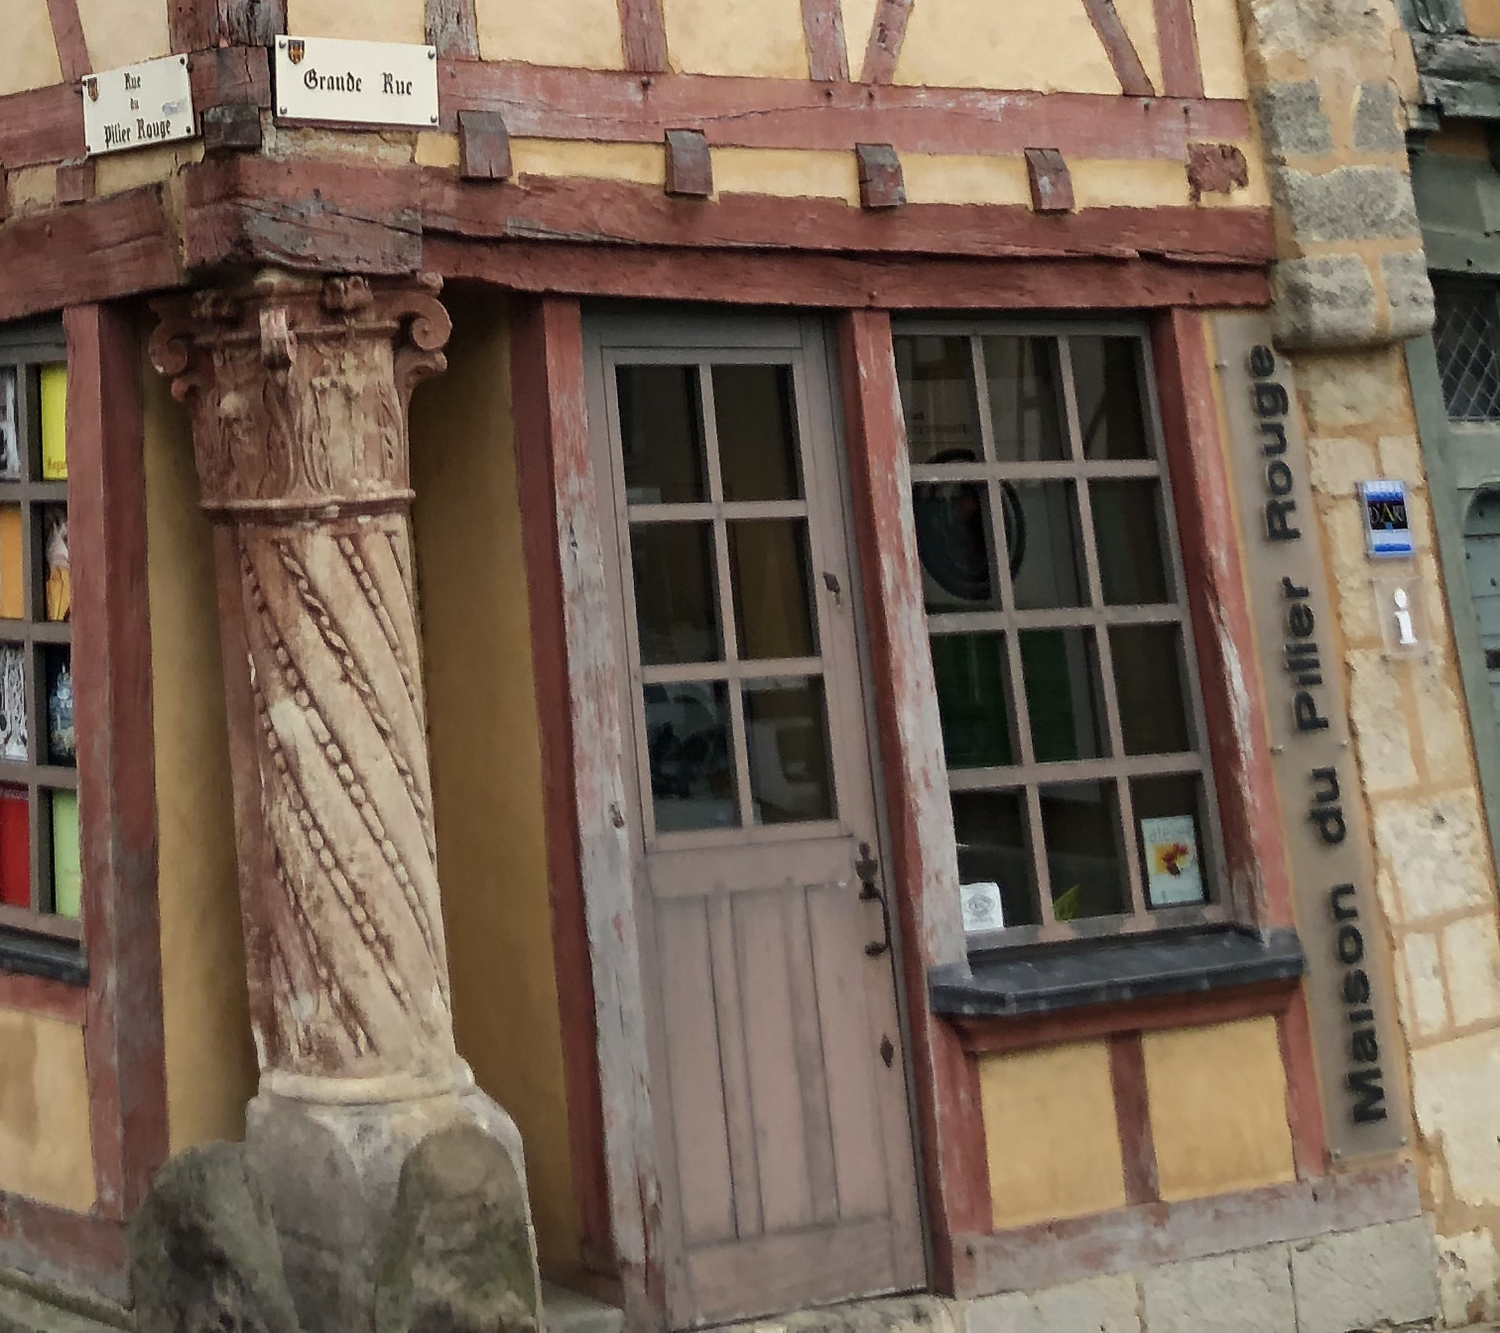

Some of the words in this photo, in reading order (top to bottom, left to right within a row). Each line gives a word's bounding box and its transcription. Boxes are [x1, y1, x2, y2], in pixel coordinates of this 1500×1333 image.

[123, 72, 141, 90] Rue
[130, 97, 140, 110] du
[304, 68, 362, 93] Grande
[381, 72, 412, 95] Rue
[104, 122, 131, 148] Pilier
[137, 118, 171, 139] Rouge
[1250, 344, 1302, 542] Rouge
[1281, 575, 1329, 732] Pilier
[1310, 766, 1347, 845] du
[1331, 882, 1388, 1125] Maison
